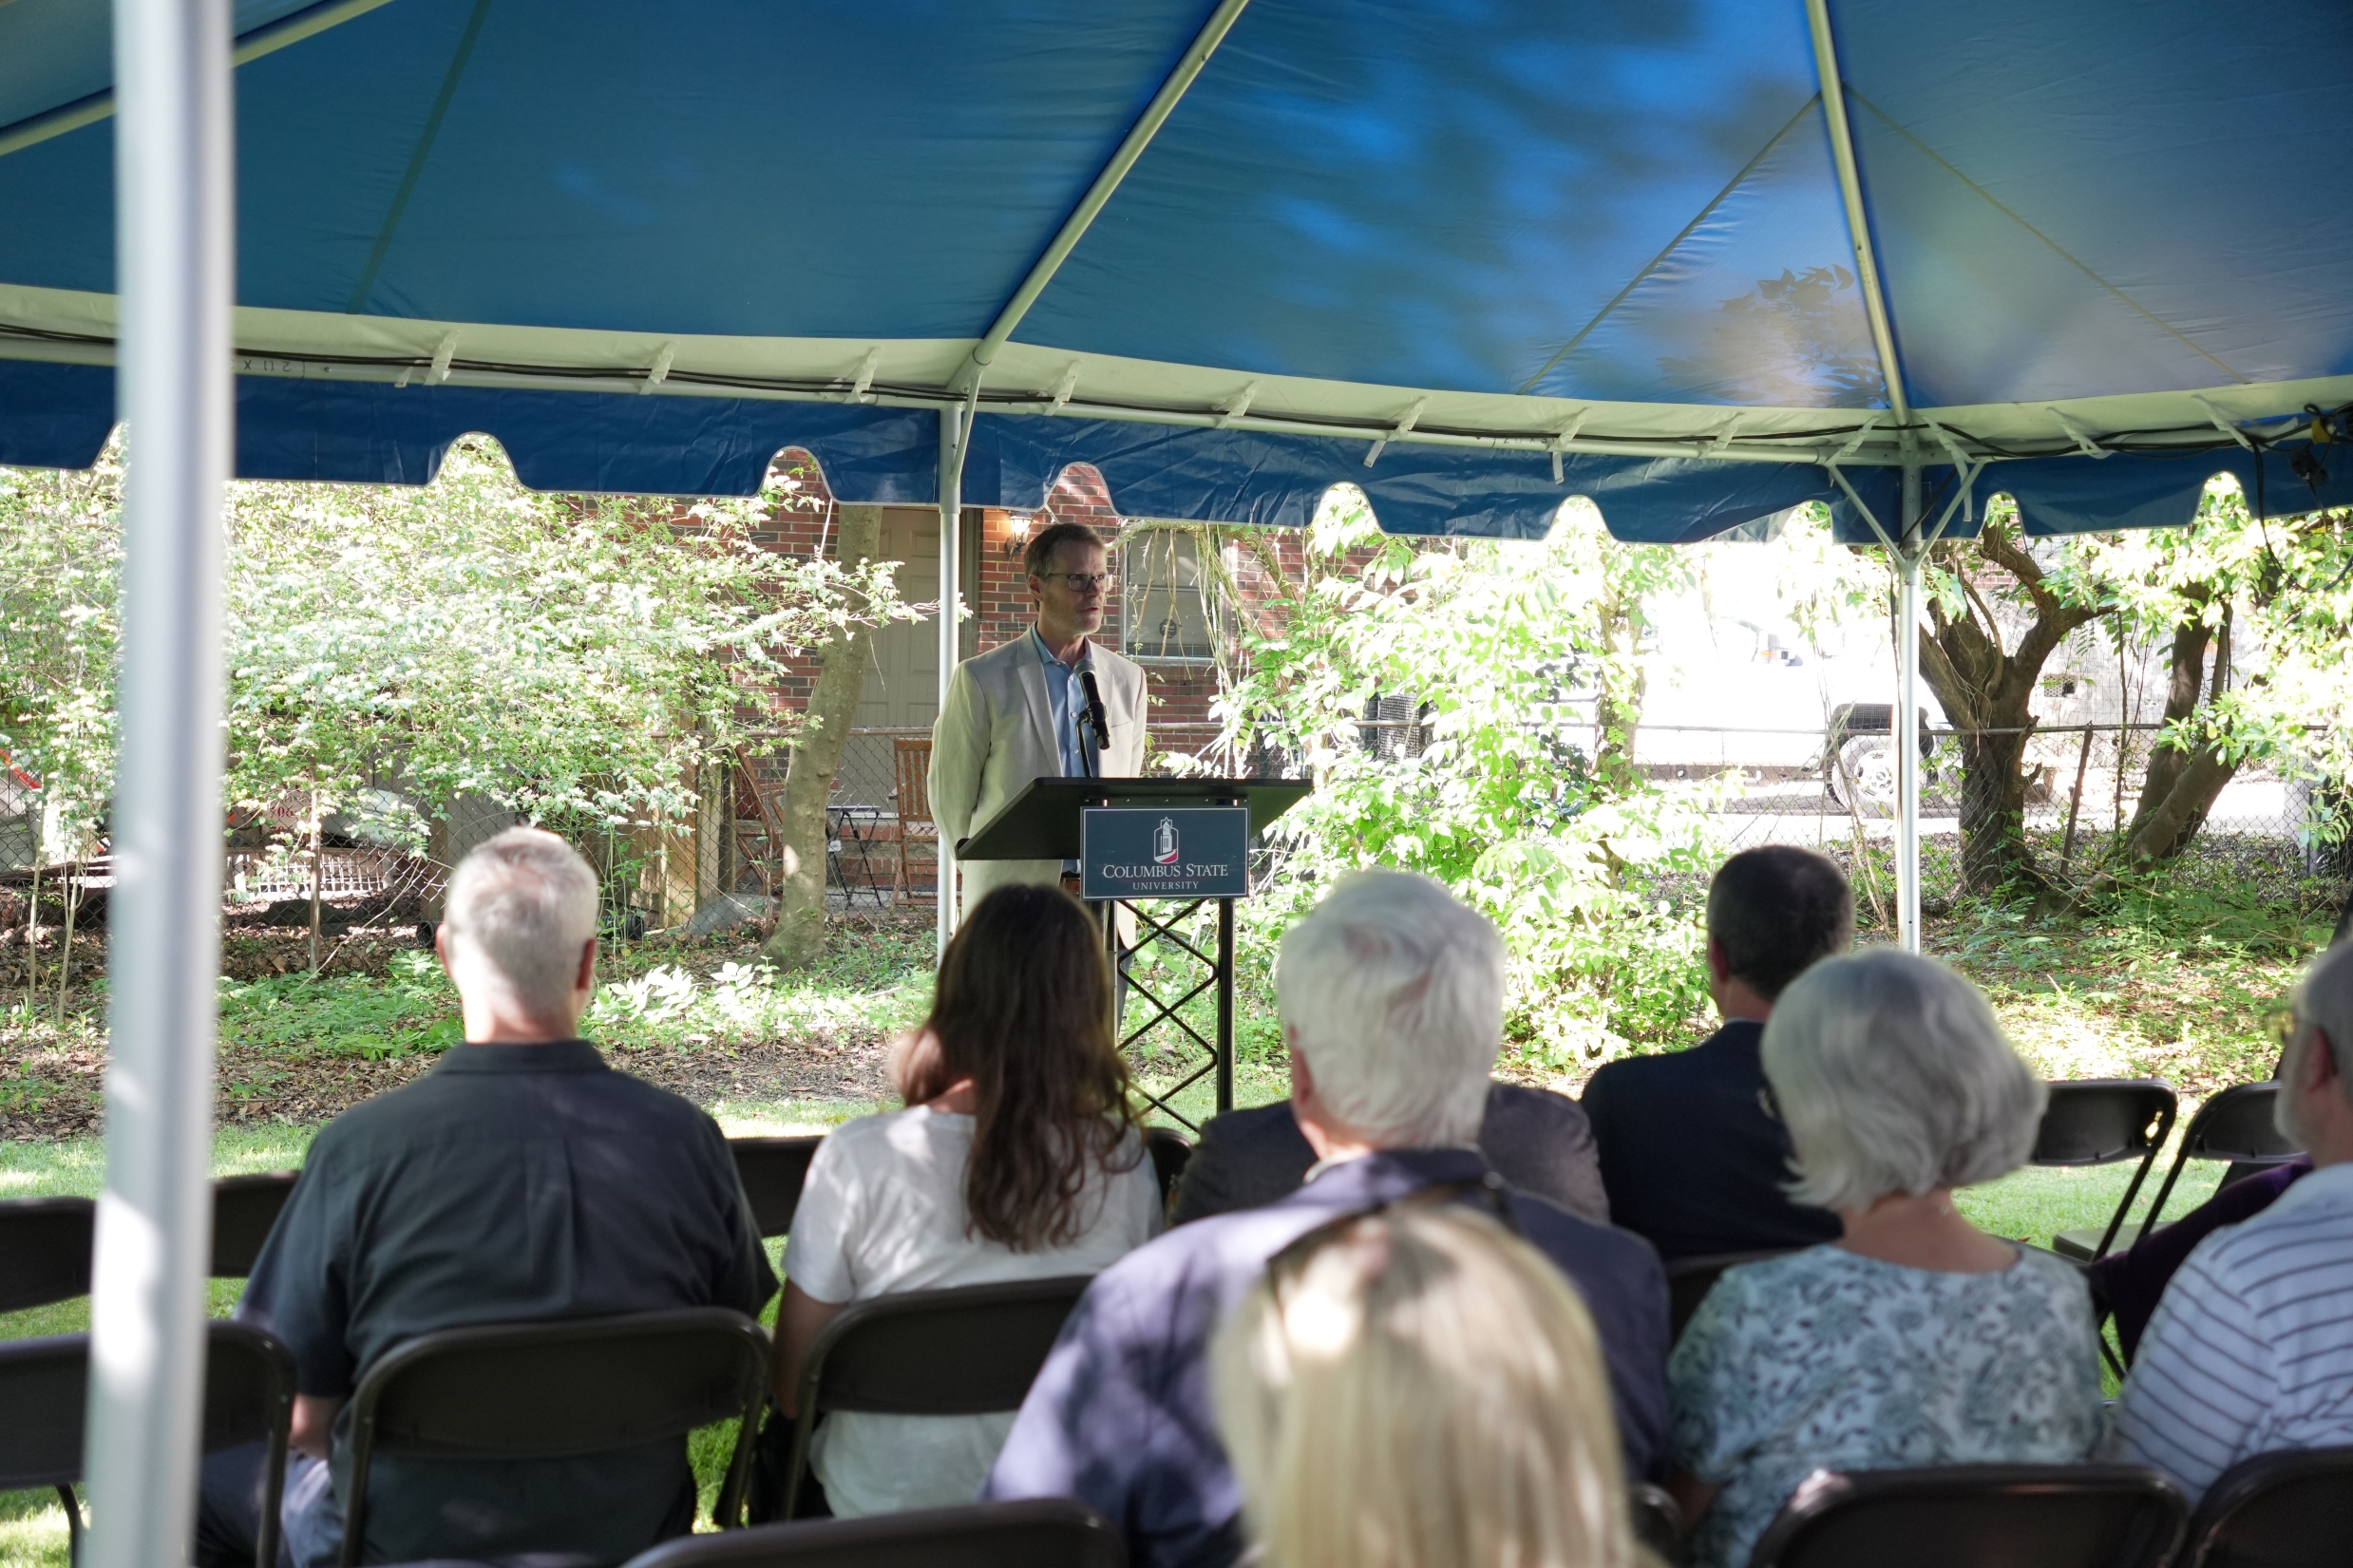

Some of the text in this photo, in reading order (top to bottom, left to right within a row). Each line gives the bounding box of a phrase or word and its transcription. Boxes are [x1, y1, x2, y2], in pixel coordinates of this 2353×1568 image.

[1102, 863, 1229, 878] COLUMBUS STATE
[1132, 881, 1199, 890] UNIVERSITY
